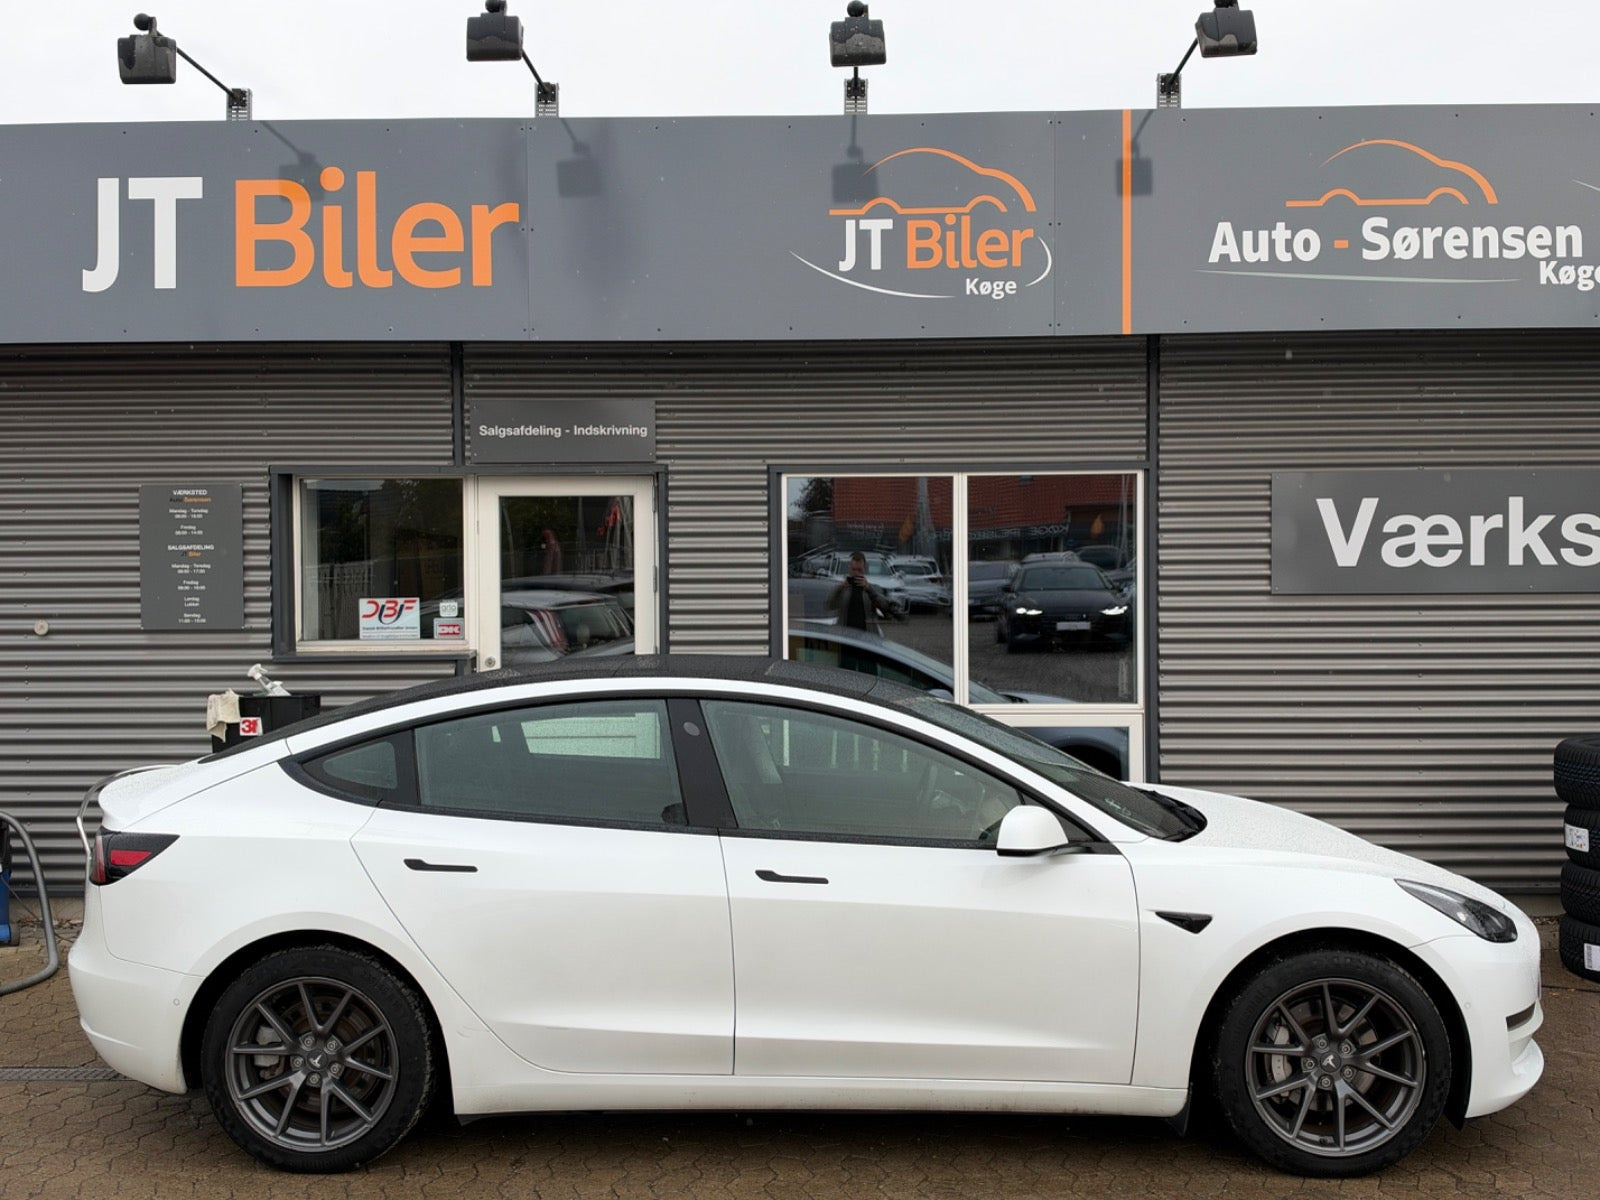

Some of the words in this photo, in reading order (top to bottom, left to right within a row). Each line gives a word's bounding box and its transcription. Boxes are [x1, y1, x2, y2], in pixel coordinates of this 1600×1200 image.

[83, 177, 203, 292] JT
[236, 167, 520, 288] Biler
[839, 219, 894, 272] JT
[907, 214, 1034, 269] Biler
[1208, 222, 1321, 263] Auto
[1362, 217, 1583, 261] Sørensen
[966, 278, 1017, 299] Køge
[479, 425, 562, 438] Salgsafdeling
[574, 424, 648, 438] Indskrivning
